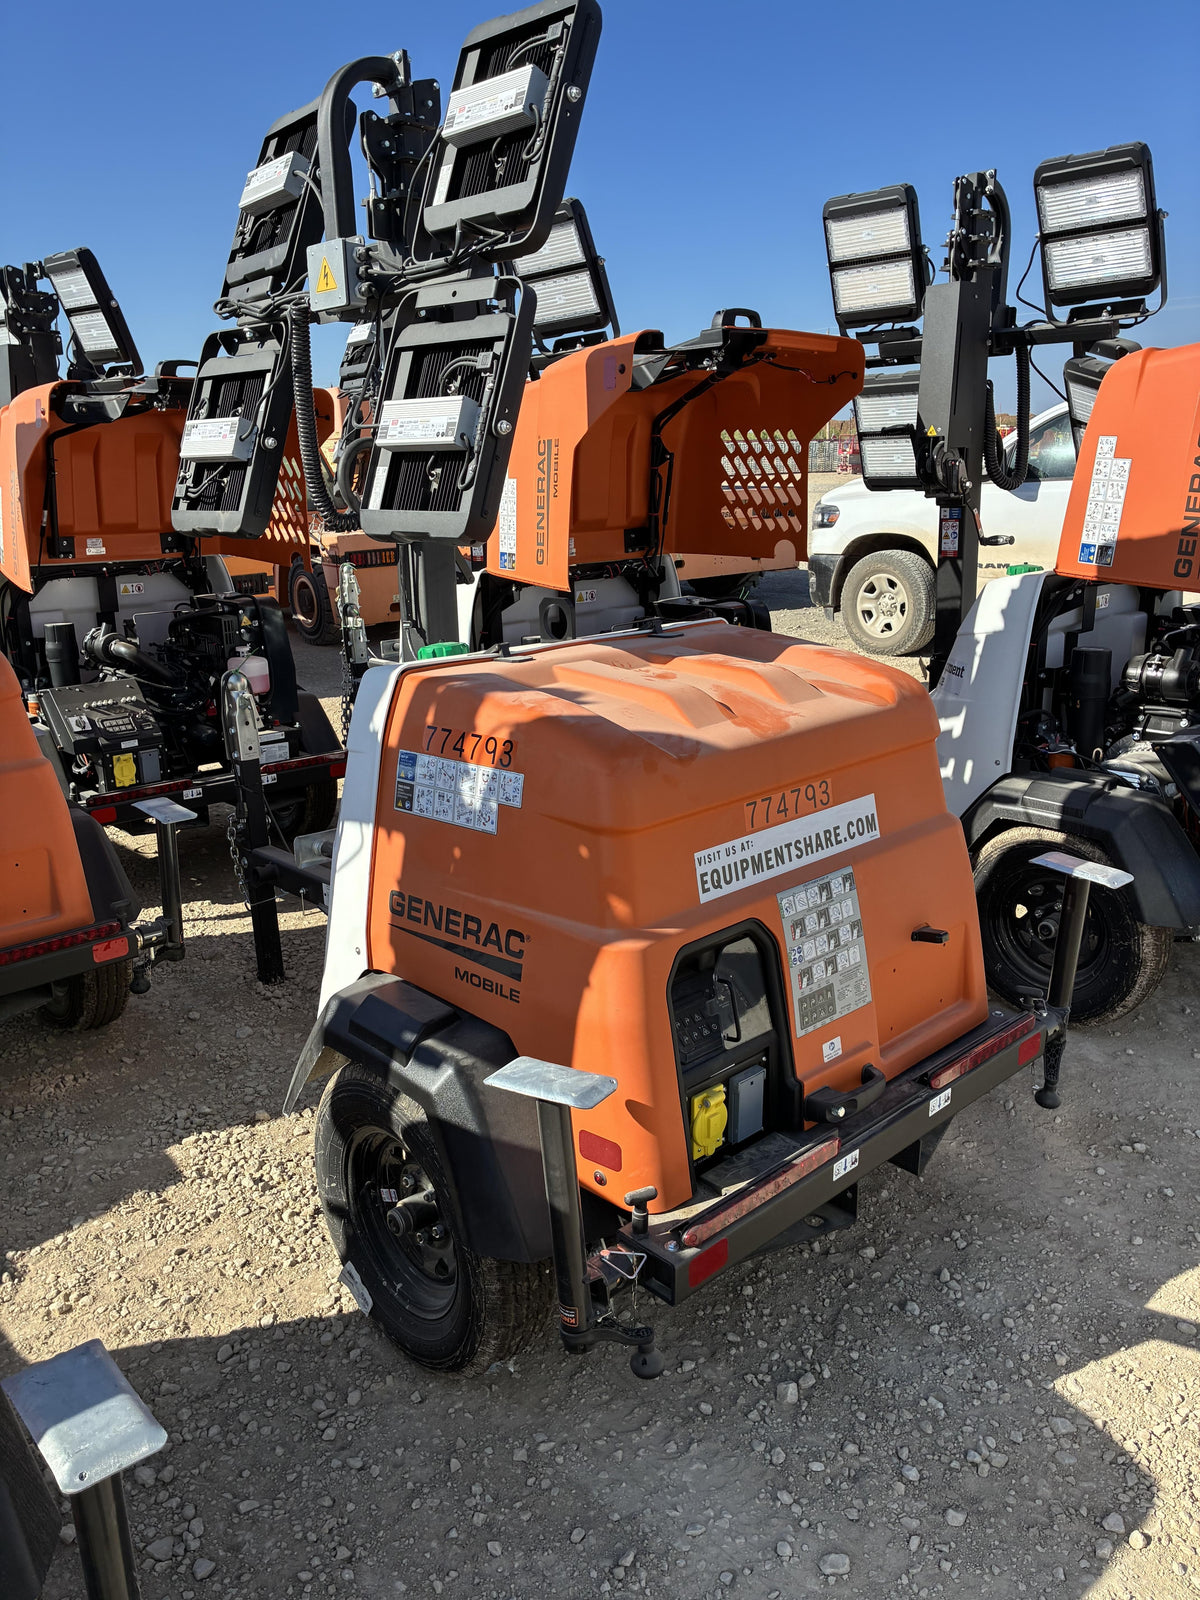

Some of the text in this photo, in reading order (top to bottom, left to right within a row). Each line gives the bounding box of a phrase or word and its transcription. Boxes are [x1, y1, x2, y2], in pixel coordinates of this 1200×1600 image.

[552, 438, 560, 498] MOBILE
[536, 439, 547, 565] GENERAC
[426, 725, 515, 769] 774793
[745, 780, 830, 829] 774793
[697, 840, 754, 867] VISIT US AT:
[699, 812, 878, 895] EQUIPMENTSHARE.COM
[388, 890, 526, 960] GENERAC
[454, 966, 521, 1004] MOBILE
